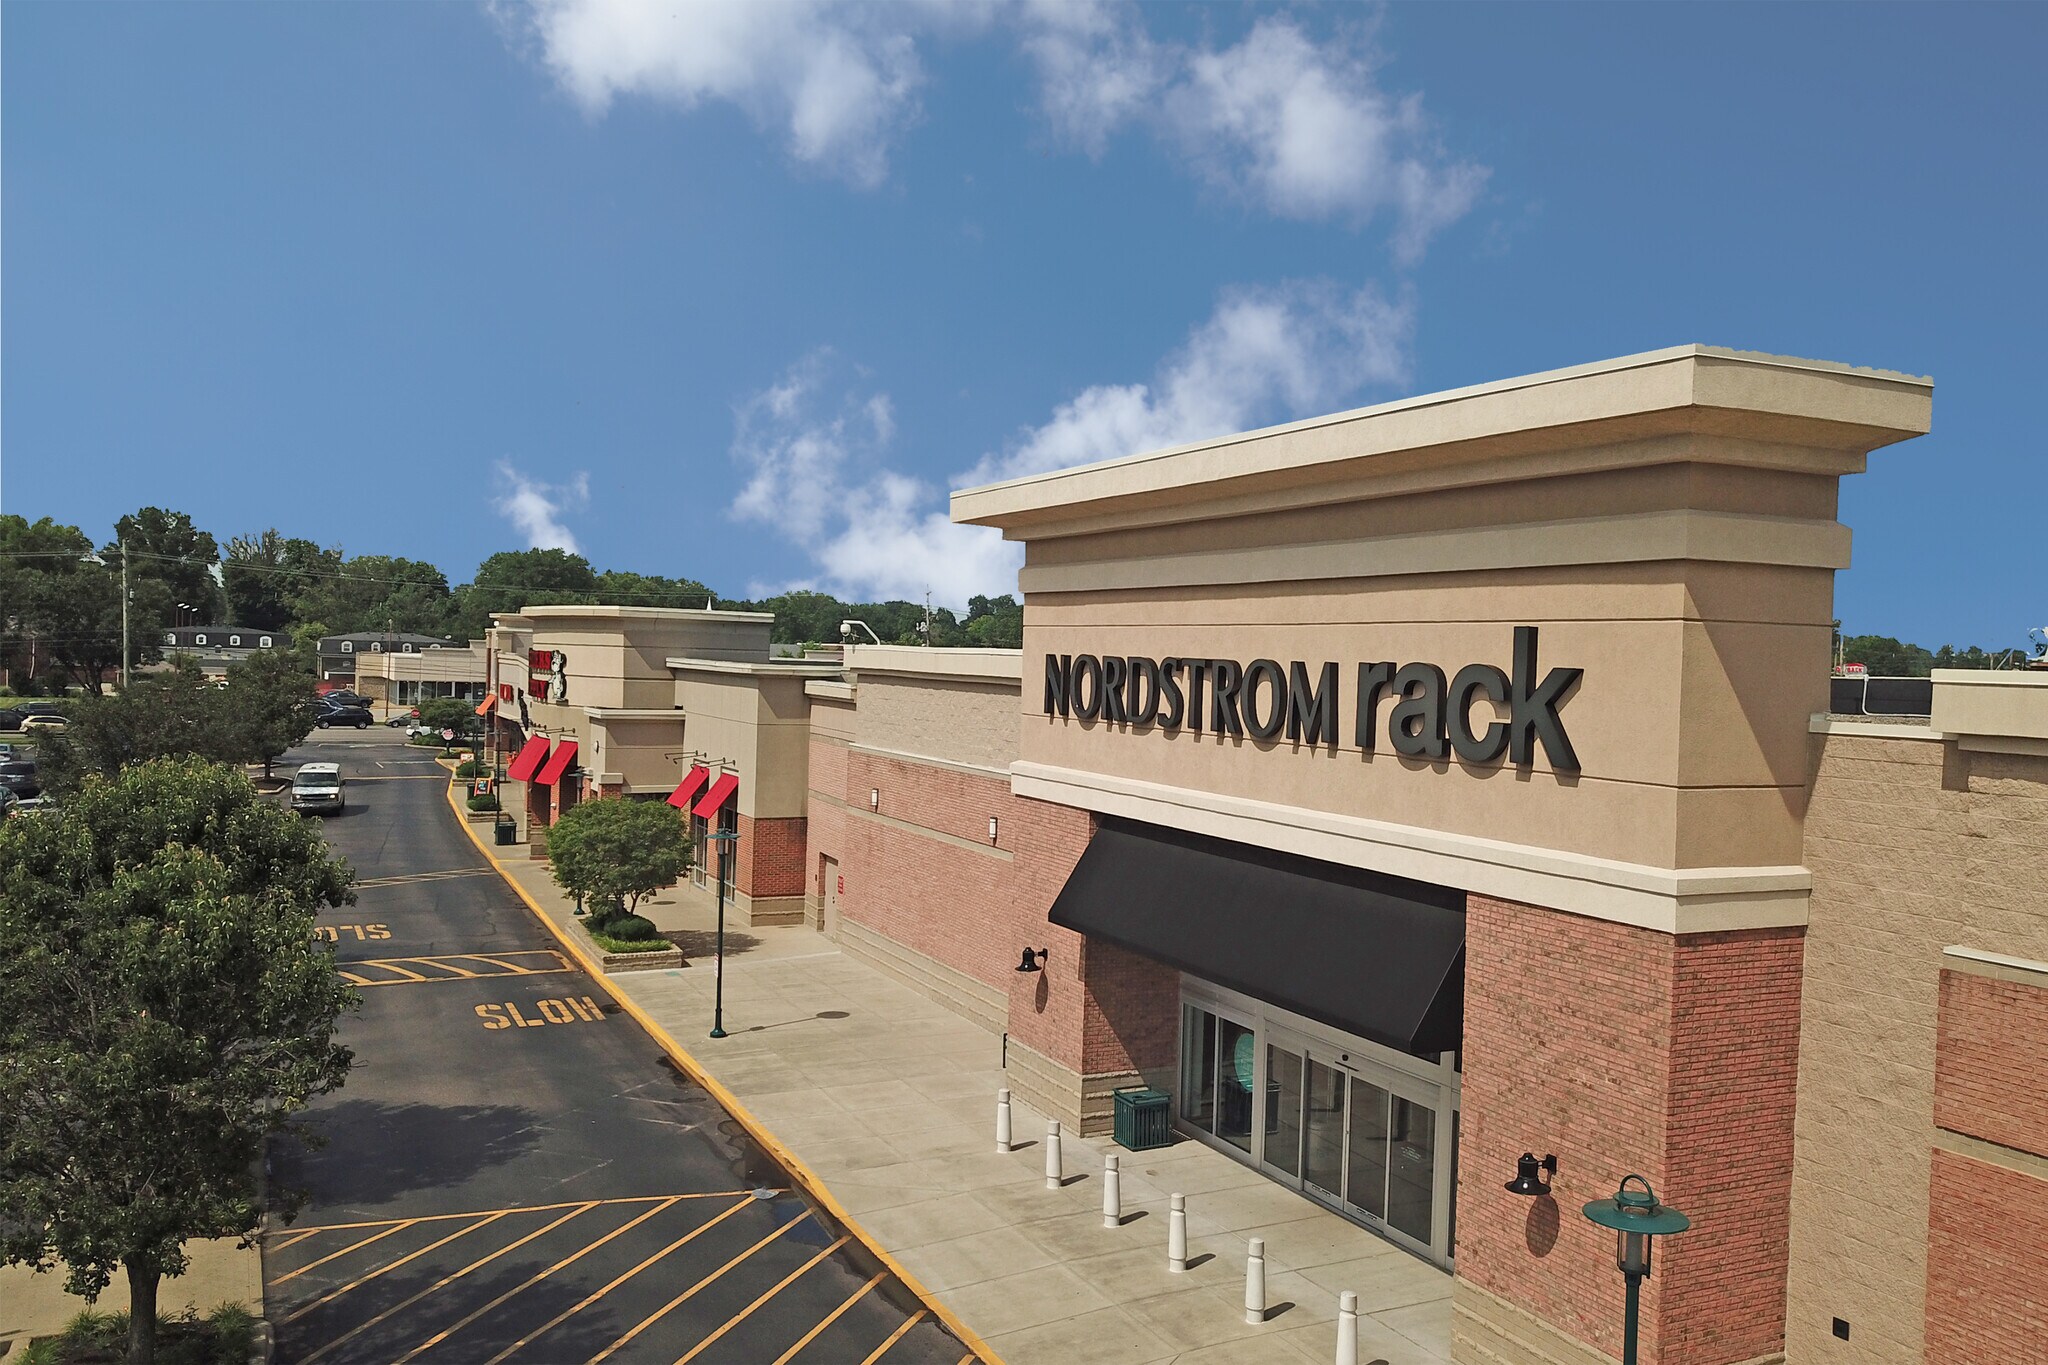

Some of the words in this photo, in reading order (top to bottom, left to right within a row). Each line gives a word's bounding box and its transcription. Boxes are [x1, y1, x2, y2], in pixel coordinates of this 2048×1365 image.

[1044, 653, 1339, 745] NORDSTROM
[1355, 626, 1584, 770] rack
[474, 995, 607, 1030] SLOW
